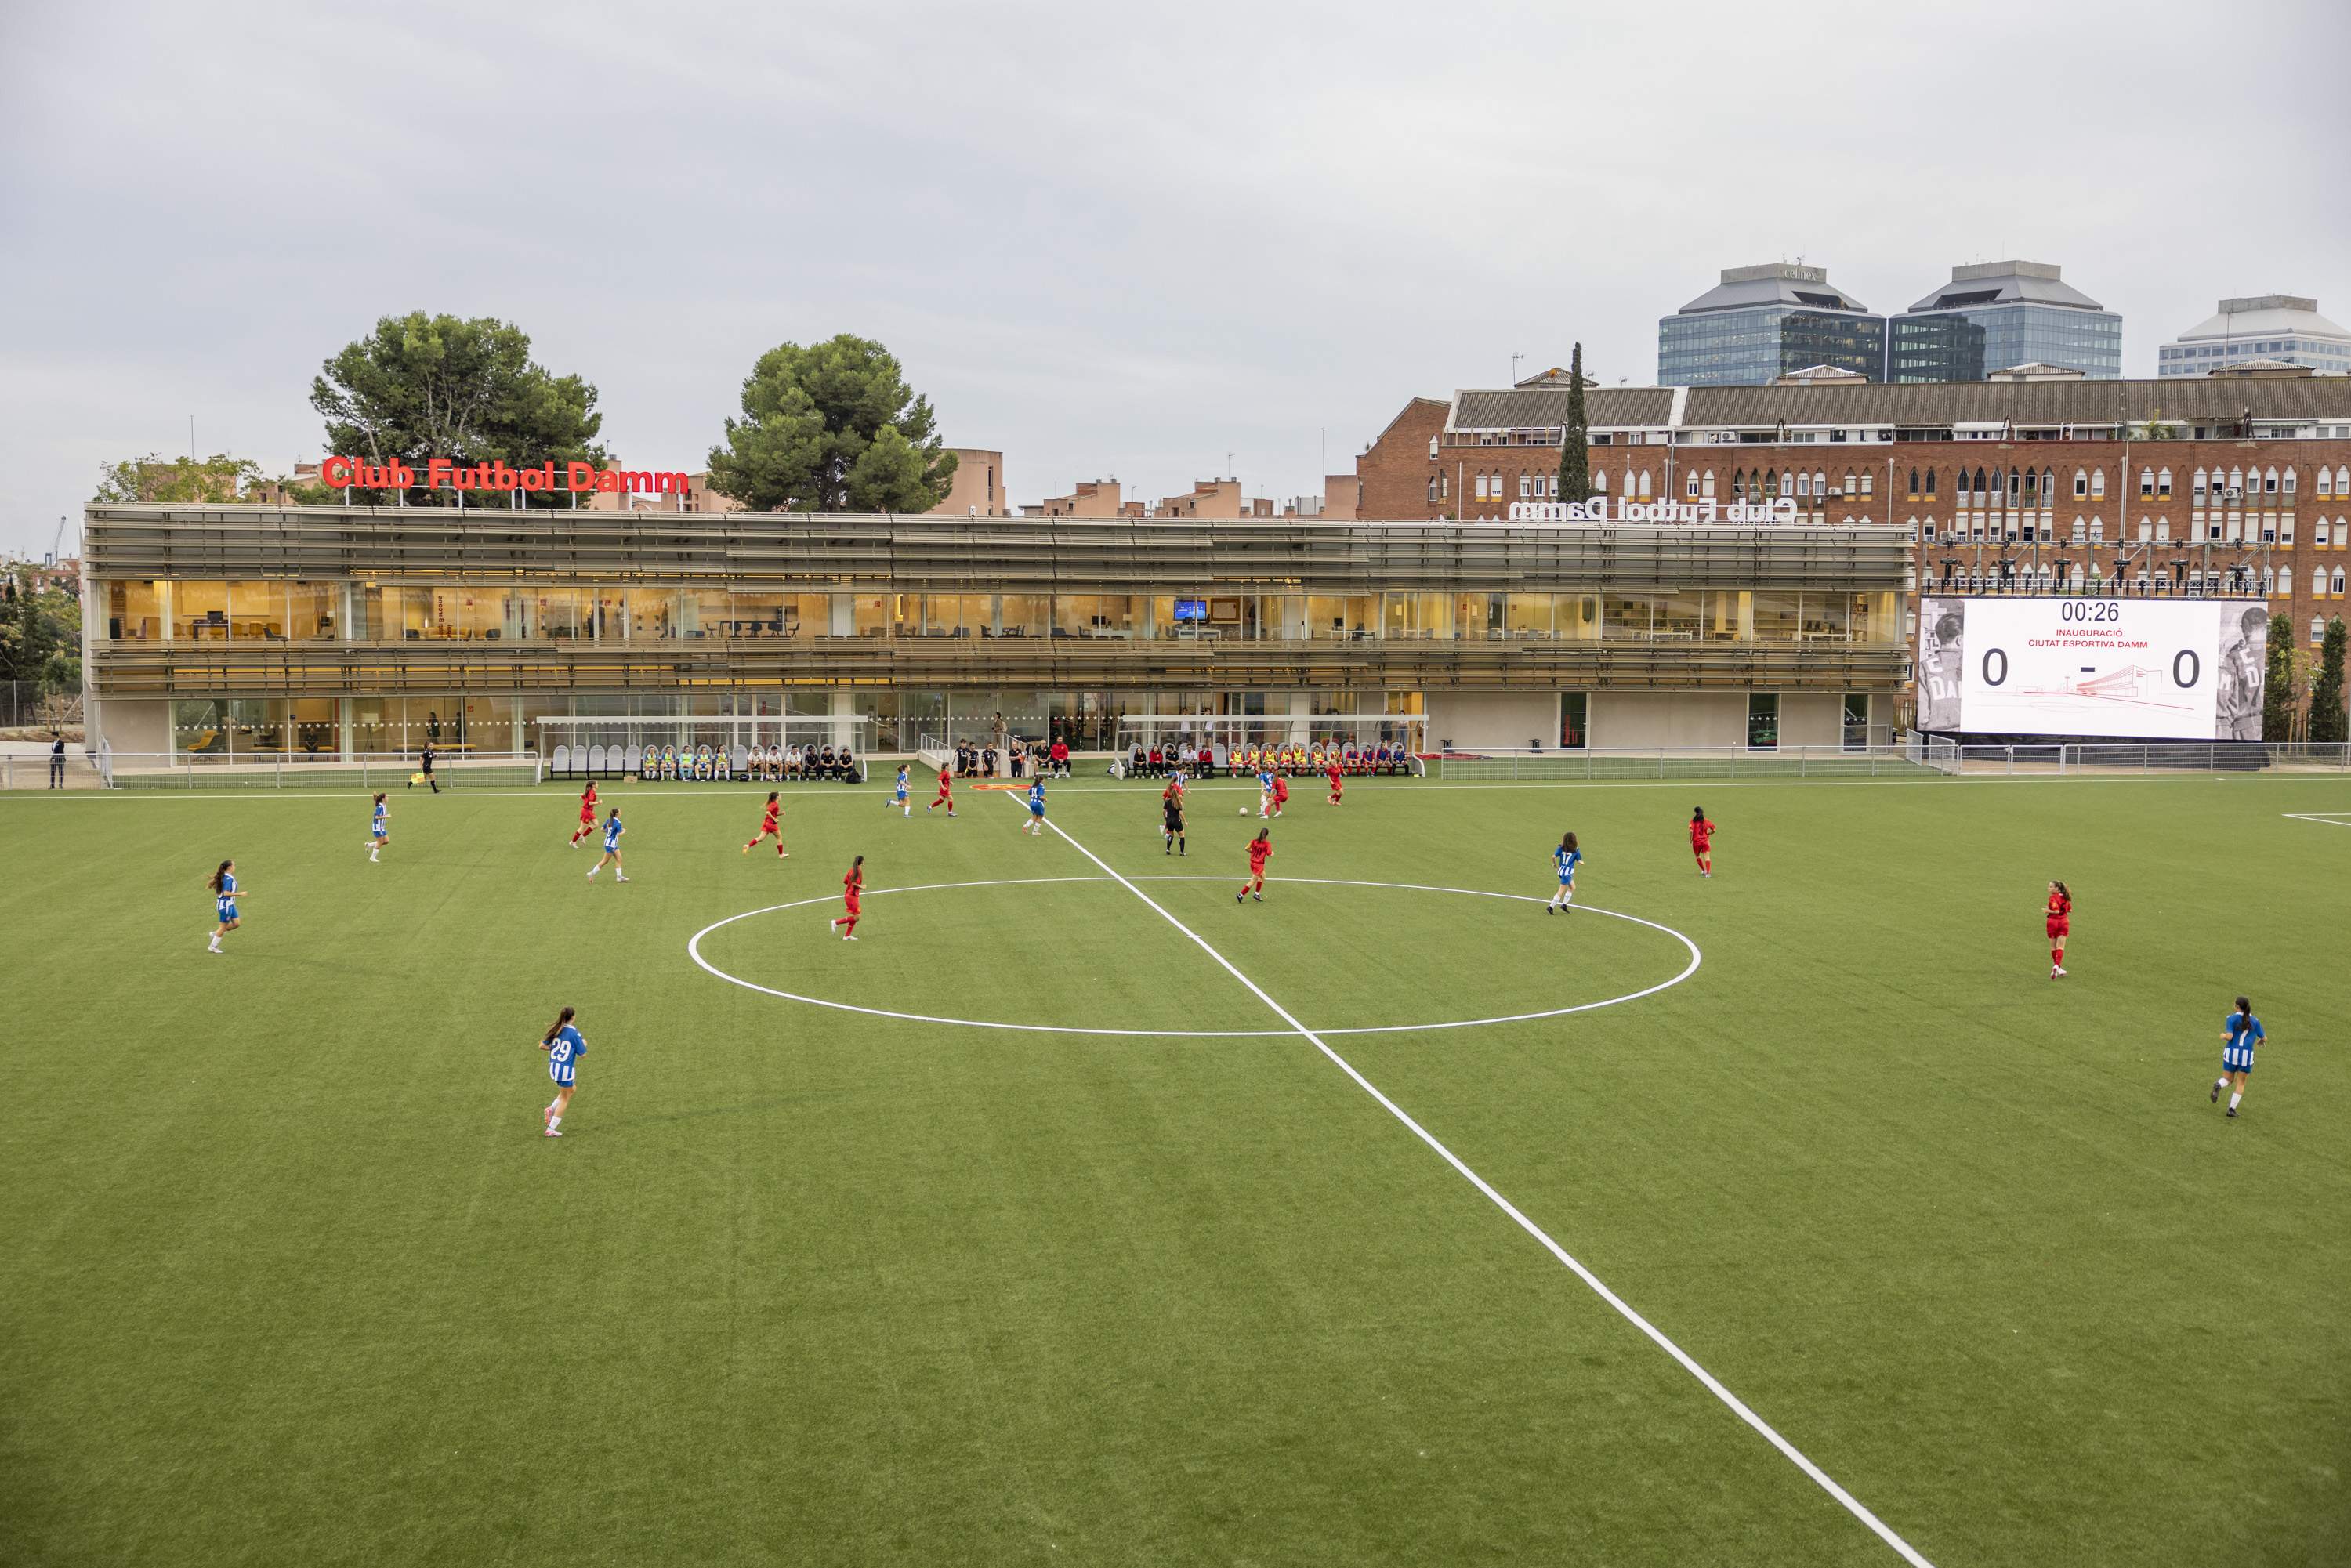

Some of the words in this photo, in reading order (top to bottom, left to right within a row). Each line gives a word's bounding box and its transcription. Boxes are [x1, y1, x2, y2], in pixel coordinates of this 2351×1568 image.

[1784, 267, 1816, 281] cellnex
[322, 455, 415, 490] Club
[429, 458, 554, 491] Futbol
[567, 461, 689, 494] Damm
[2062, 602, 2119, 621] 00:26
[2056, 628, 2123, 637] INAUGURACIÓ
[1982, 648, 2008, 686] 0
[2172, 650, 2201, 689] 0
[1031, 787, 1038, 798] 14
[1561, 851, 1572, 865] 17
[550, 1037, 571, 1063] 29
